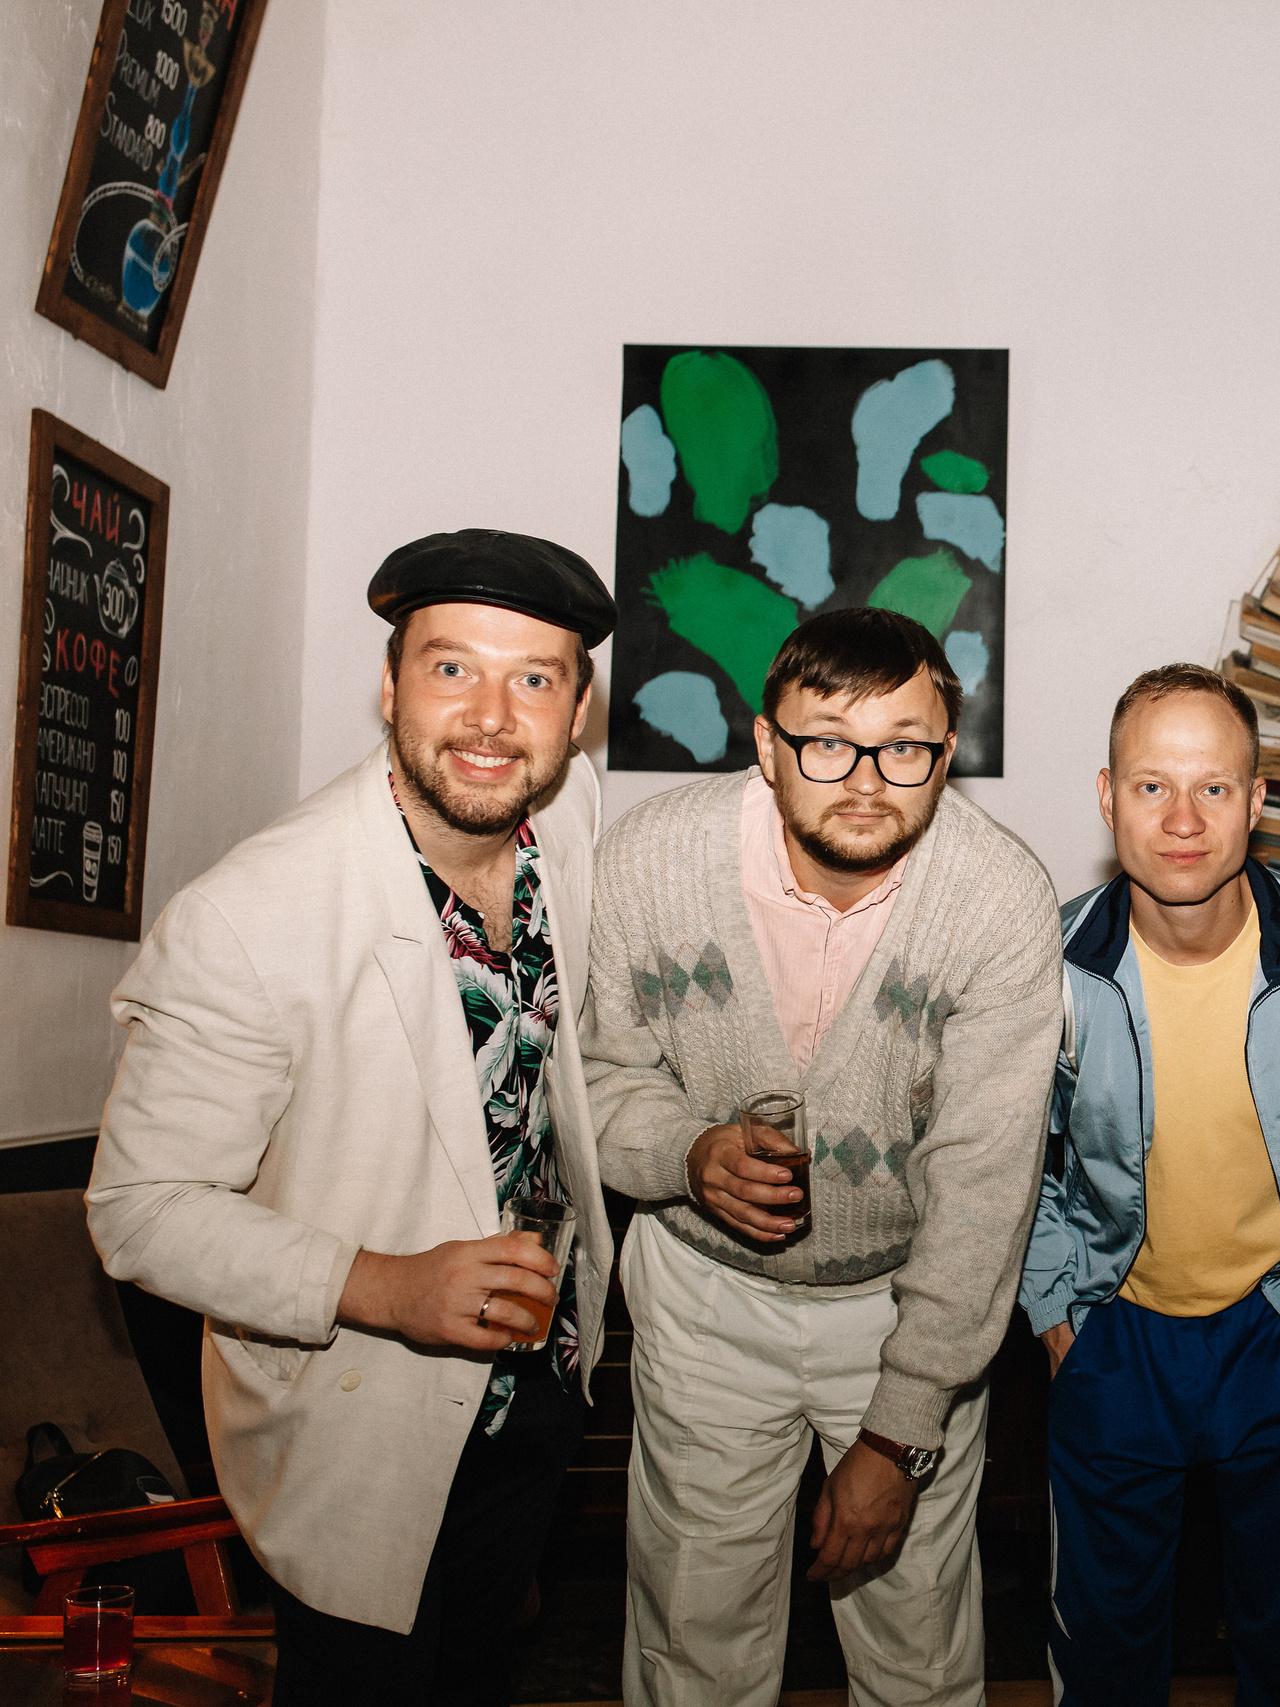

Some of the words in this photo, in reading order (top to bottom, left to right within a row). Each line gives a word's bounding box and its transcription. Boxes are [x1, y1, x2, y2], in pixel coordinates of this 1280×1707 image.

[155, 49, 180, 90] 1000
[144, 113, 166, 149] 800
[72, 481, 120, 546] ЧАЙ
[103, 582, 125, 624] 300
[55, 628, 121, 698] КОФЕ
[115, 708, 131, 744] 100
[37, 727, 96, 773] АМЕРИКАНО
[112, 749, 127, 783] 100
[107, 834, 122, 865] 150
